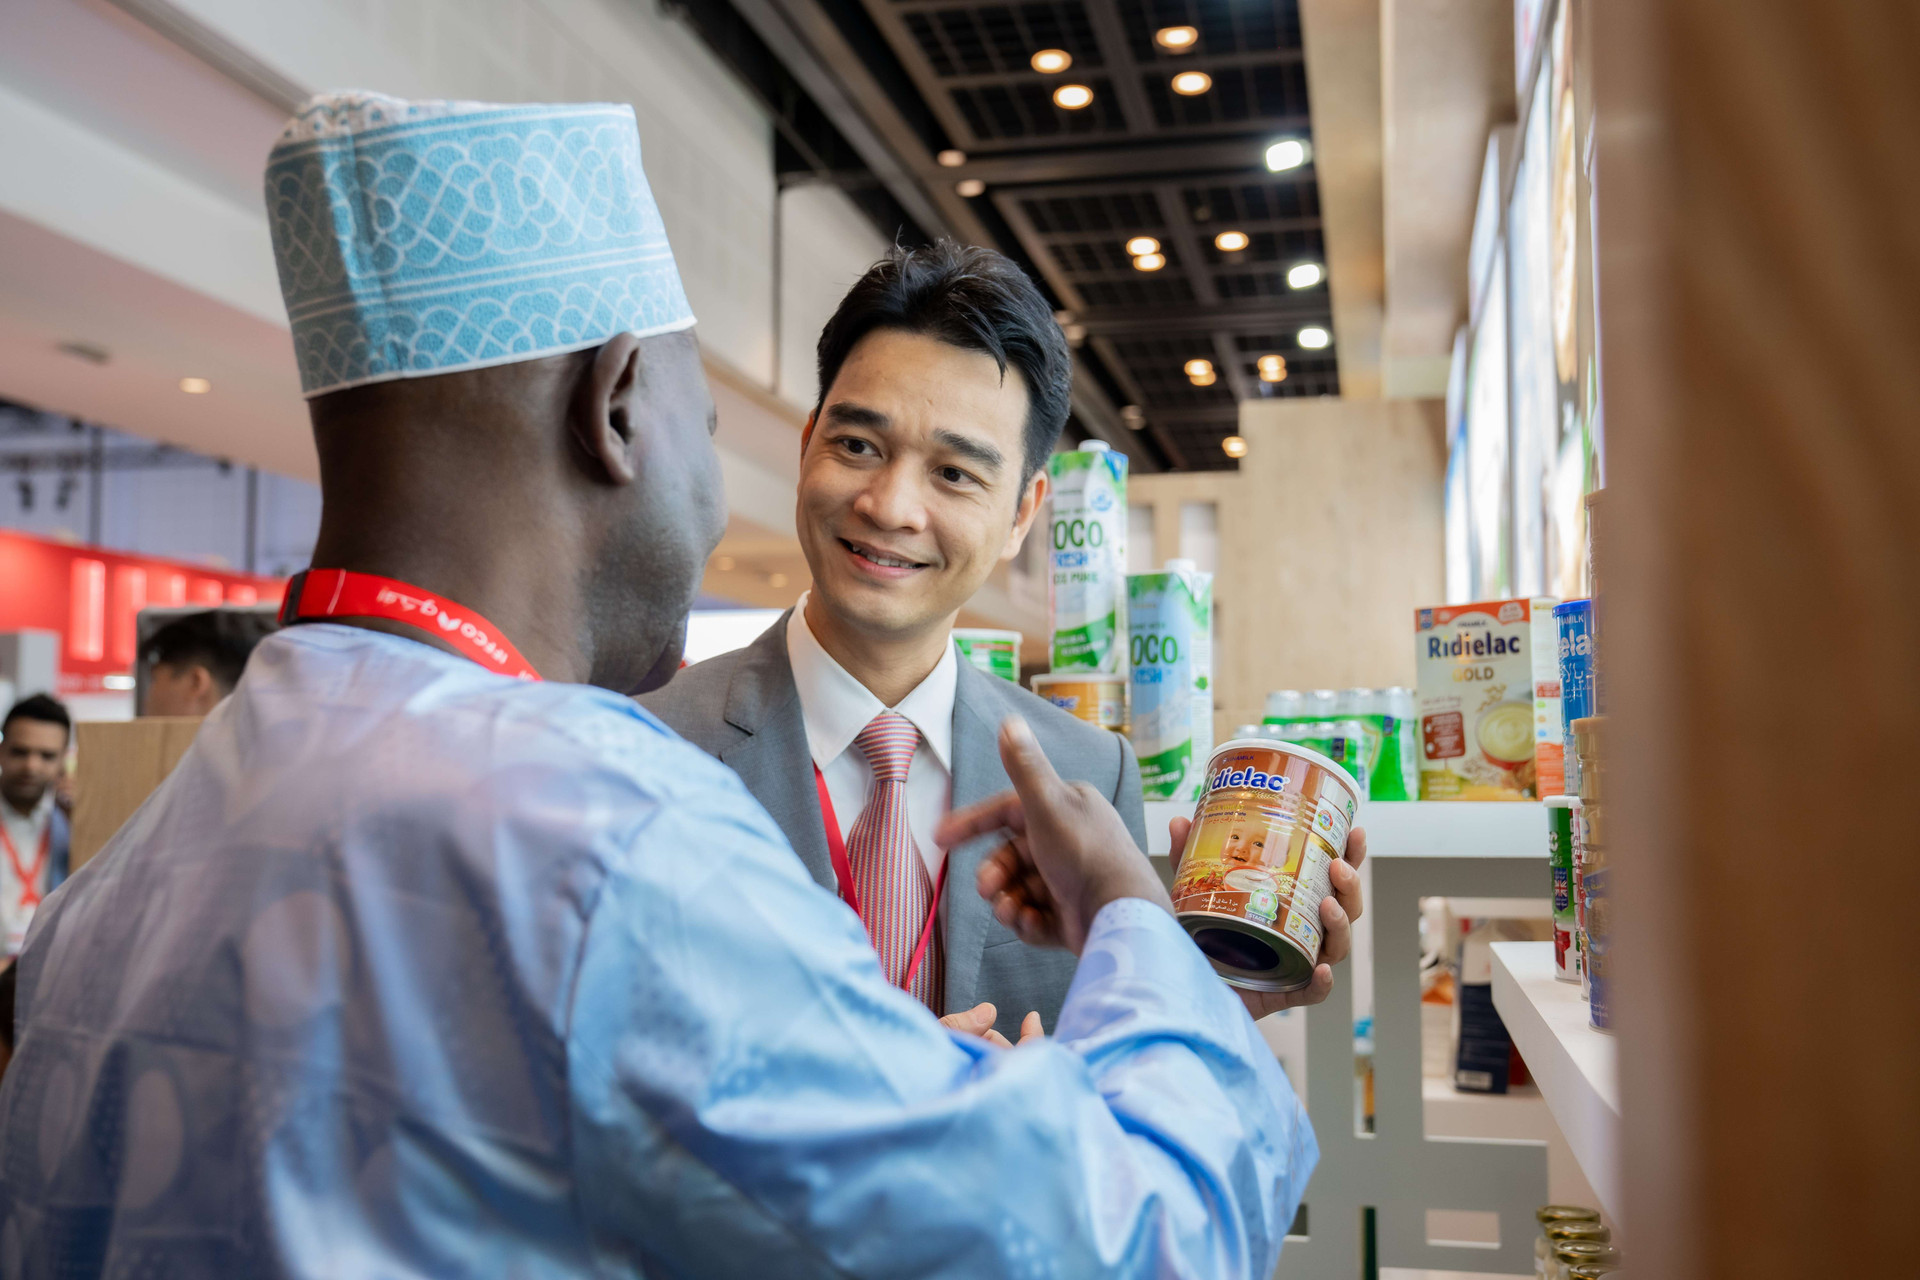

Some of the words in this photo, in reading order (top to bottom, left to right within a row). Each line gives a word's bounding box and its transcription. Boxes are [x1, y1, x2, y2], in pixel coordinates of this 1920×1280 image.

[459, 622, 510, 665] IFFCO
[1428, 631, 1520, 659] Ridielac
[1452, 666, 1494, 683] GOLD
